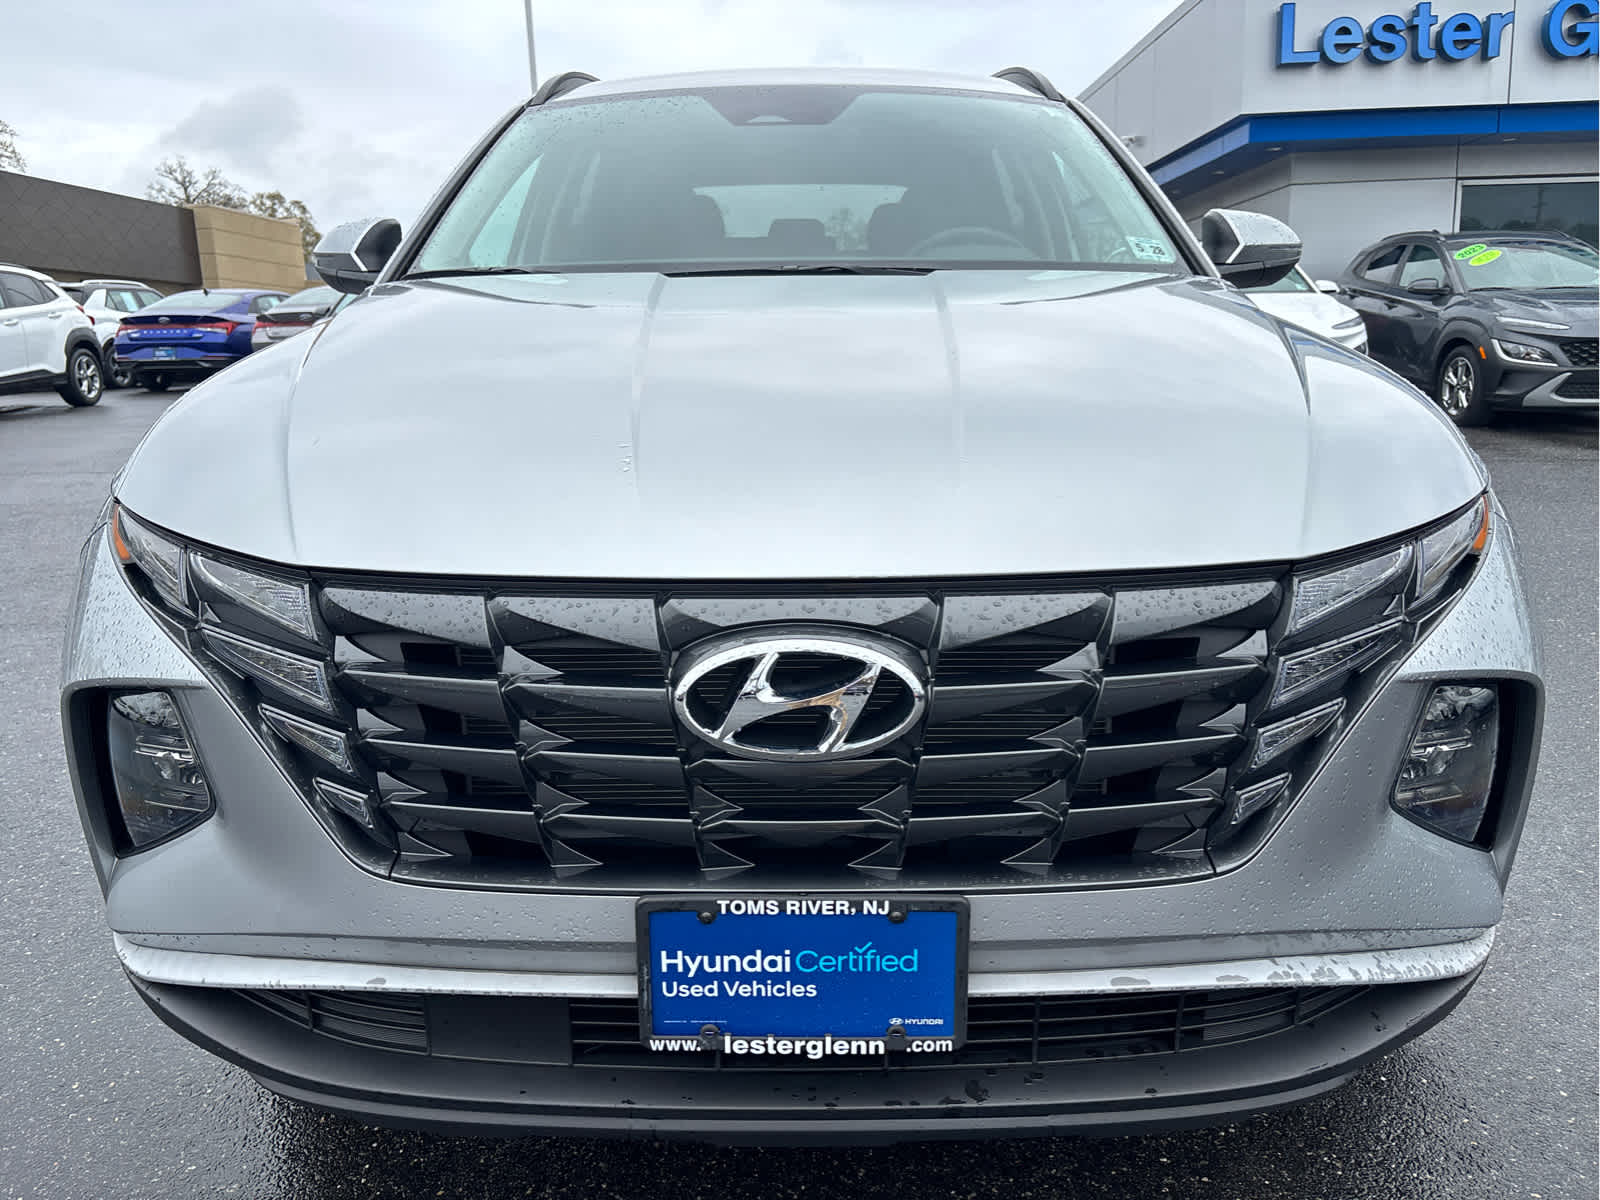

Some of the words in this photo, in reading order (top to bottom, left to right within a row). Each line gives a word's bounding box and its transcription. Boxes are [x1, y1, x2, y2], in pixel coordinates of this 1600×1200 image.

[1277, 2, 1515, 66] Lester
[1457, 244, 1486, 259] 2023
[717, 900, 780, 915] TOMS
[786, 900, 856, 917] RIVER,
[863, 900, 890, 915] NJ
[660, 949, 791, 977] Hyundai
[795, 941, 919, 973] Certified
[661, 981, 719, 997] Used
[723, 980, 817, 998] Vehicles
[649, 1038, 701, 1052] www.
[724, 1035, 885, 1059] lesterglenn
[905, 1039, 953, 1053] .com
